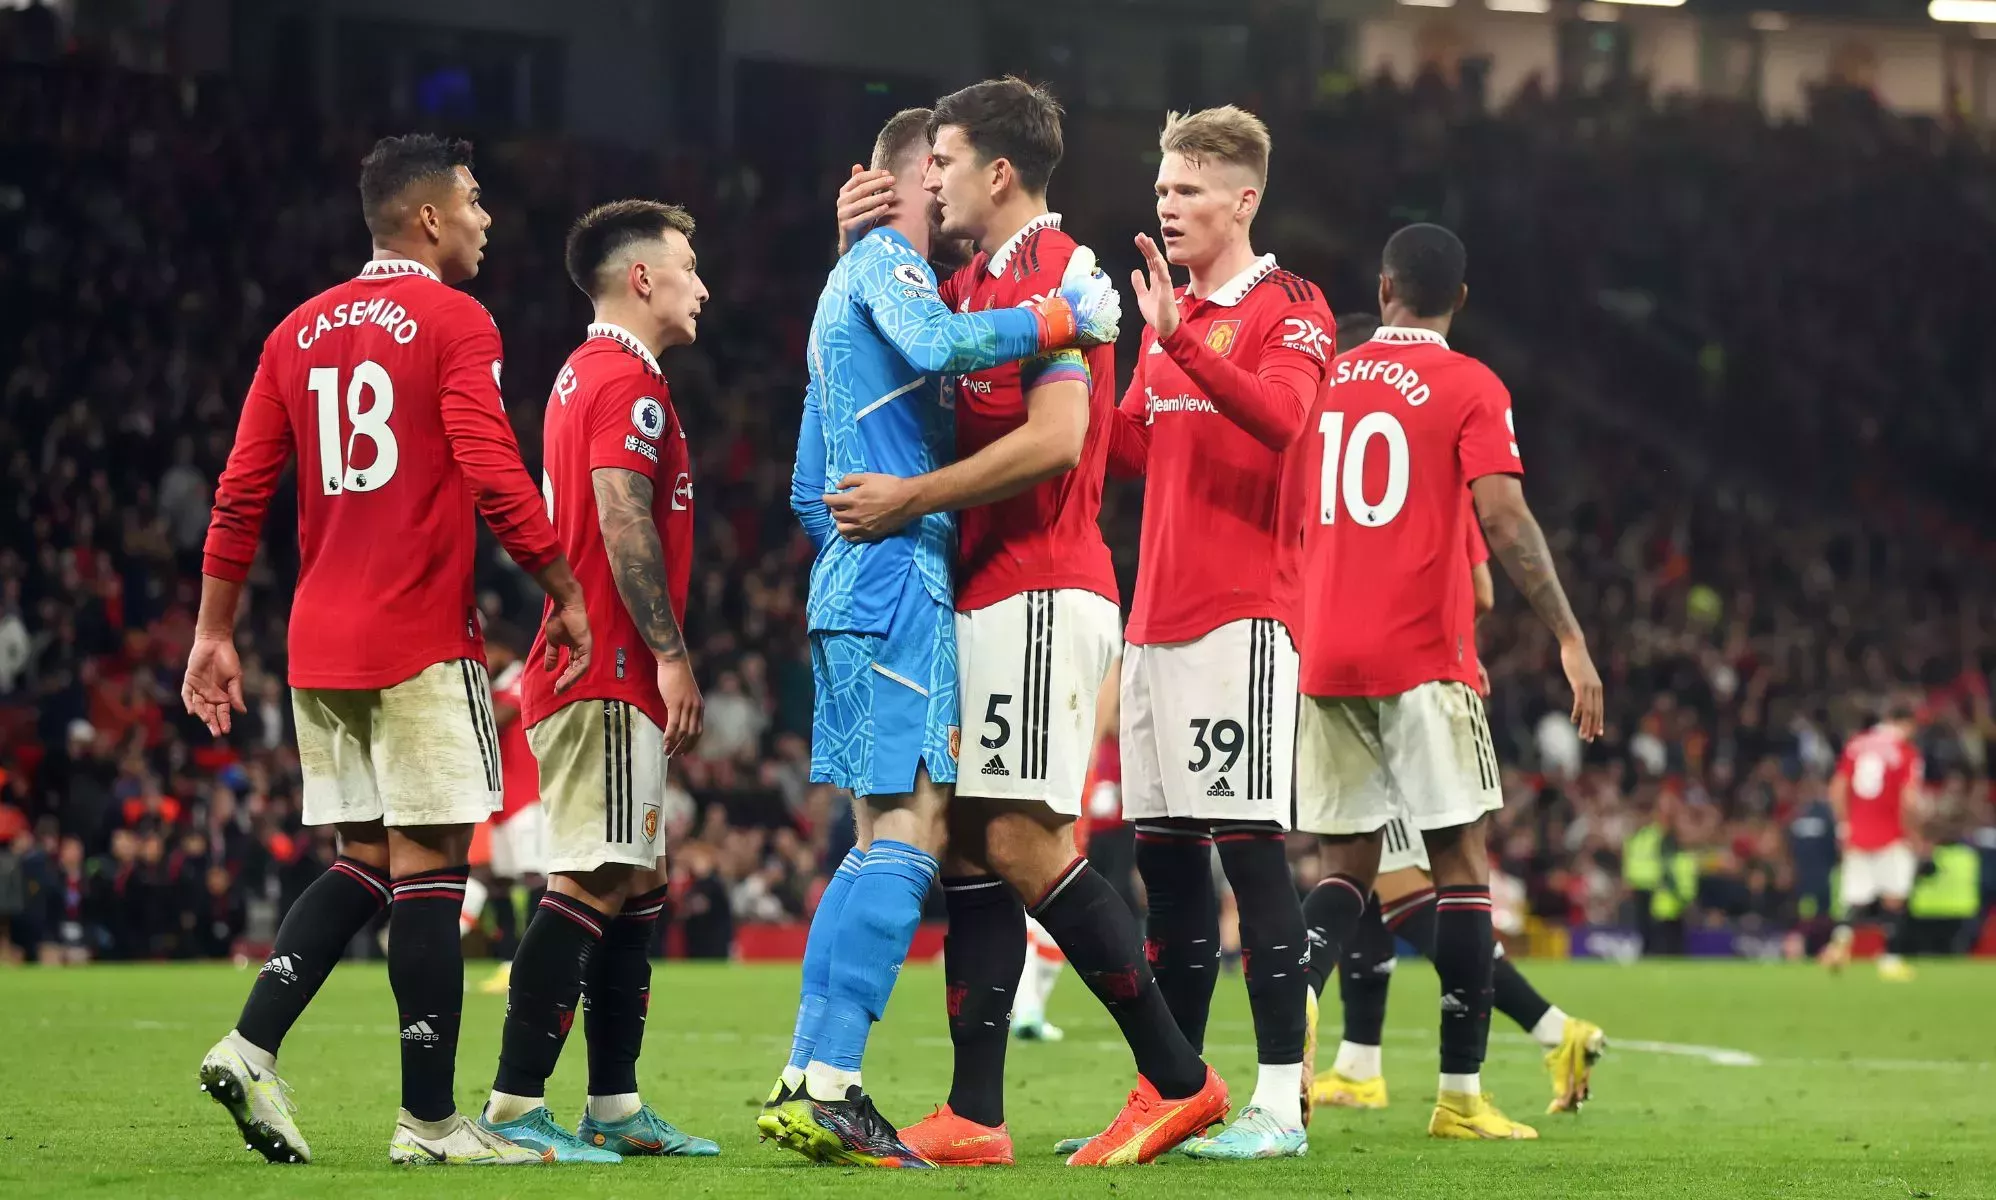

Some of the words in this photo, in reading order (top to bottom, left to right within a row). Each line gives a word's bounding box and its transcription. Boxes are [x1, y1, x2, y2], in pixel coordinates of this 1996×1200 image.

[297, 298, 418, 350] CASEMIRO
[556, 363, 578, 406] EZ
[1329, 359, 1431, 407] SHFORD
[308, 360, 398, 495] 18
[624, 442, 637, 452] for
[626, 435, 640, 445] No
[640, 440, 657, 456] room
[1318, 411, 1410, 528] 10
[980, 693, 1012, 749] 5
[1188, 718, 1245, 772] 39
[981, 766, 1010, 776] adidas
[1206, 788, 1235, 797] adidas
[400, 1030, 440, 1041] adidas
[951, 1135, 991, 1147] ULTRA
